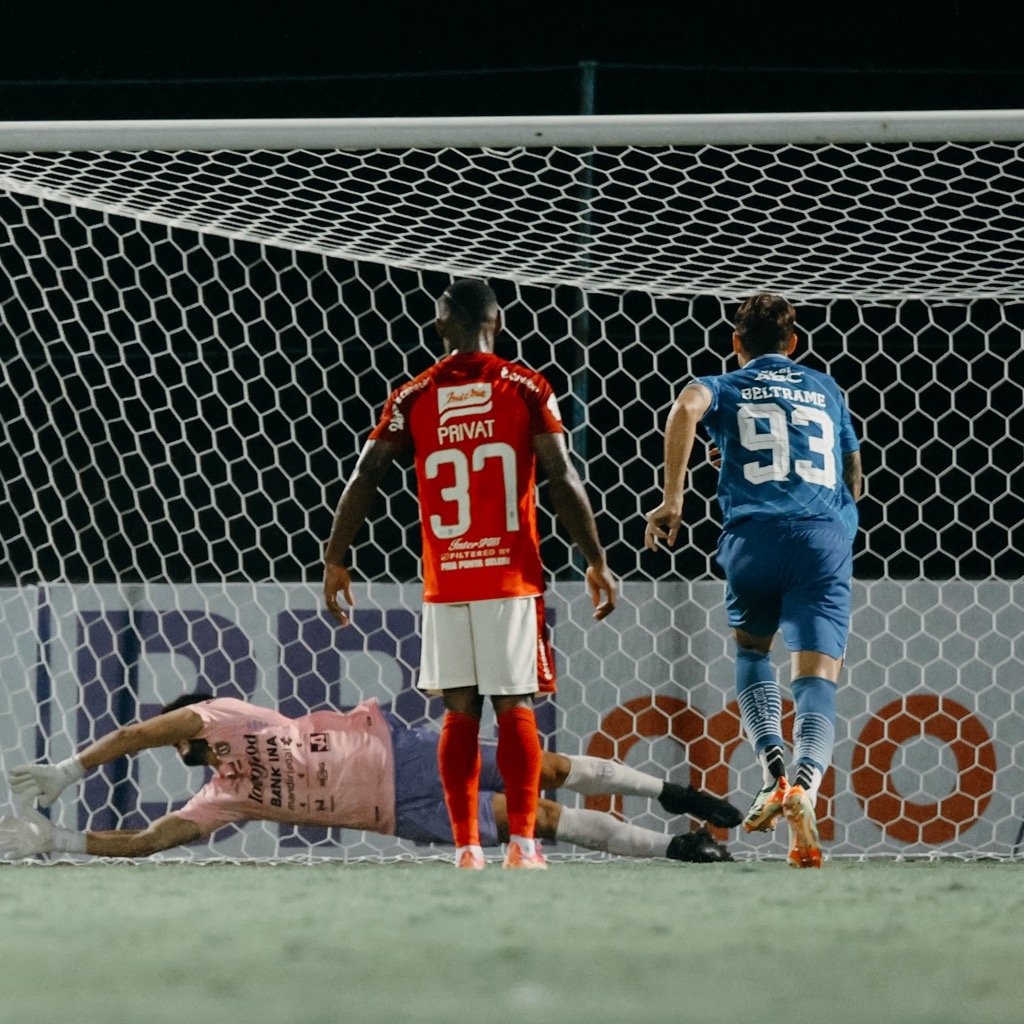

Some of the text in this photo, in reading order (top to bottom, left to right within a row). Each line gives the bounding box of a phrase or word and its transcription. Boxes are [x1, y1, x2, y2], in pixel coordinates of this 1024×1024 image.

[437, 419, 495, 445] PRIVAT
[741, 386, 826, 408] BELTRAME
[736, 402, 837, 490] 93
[425, 442, 520, 539] 37
[266, 735, 282, 808] BANK INA
